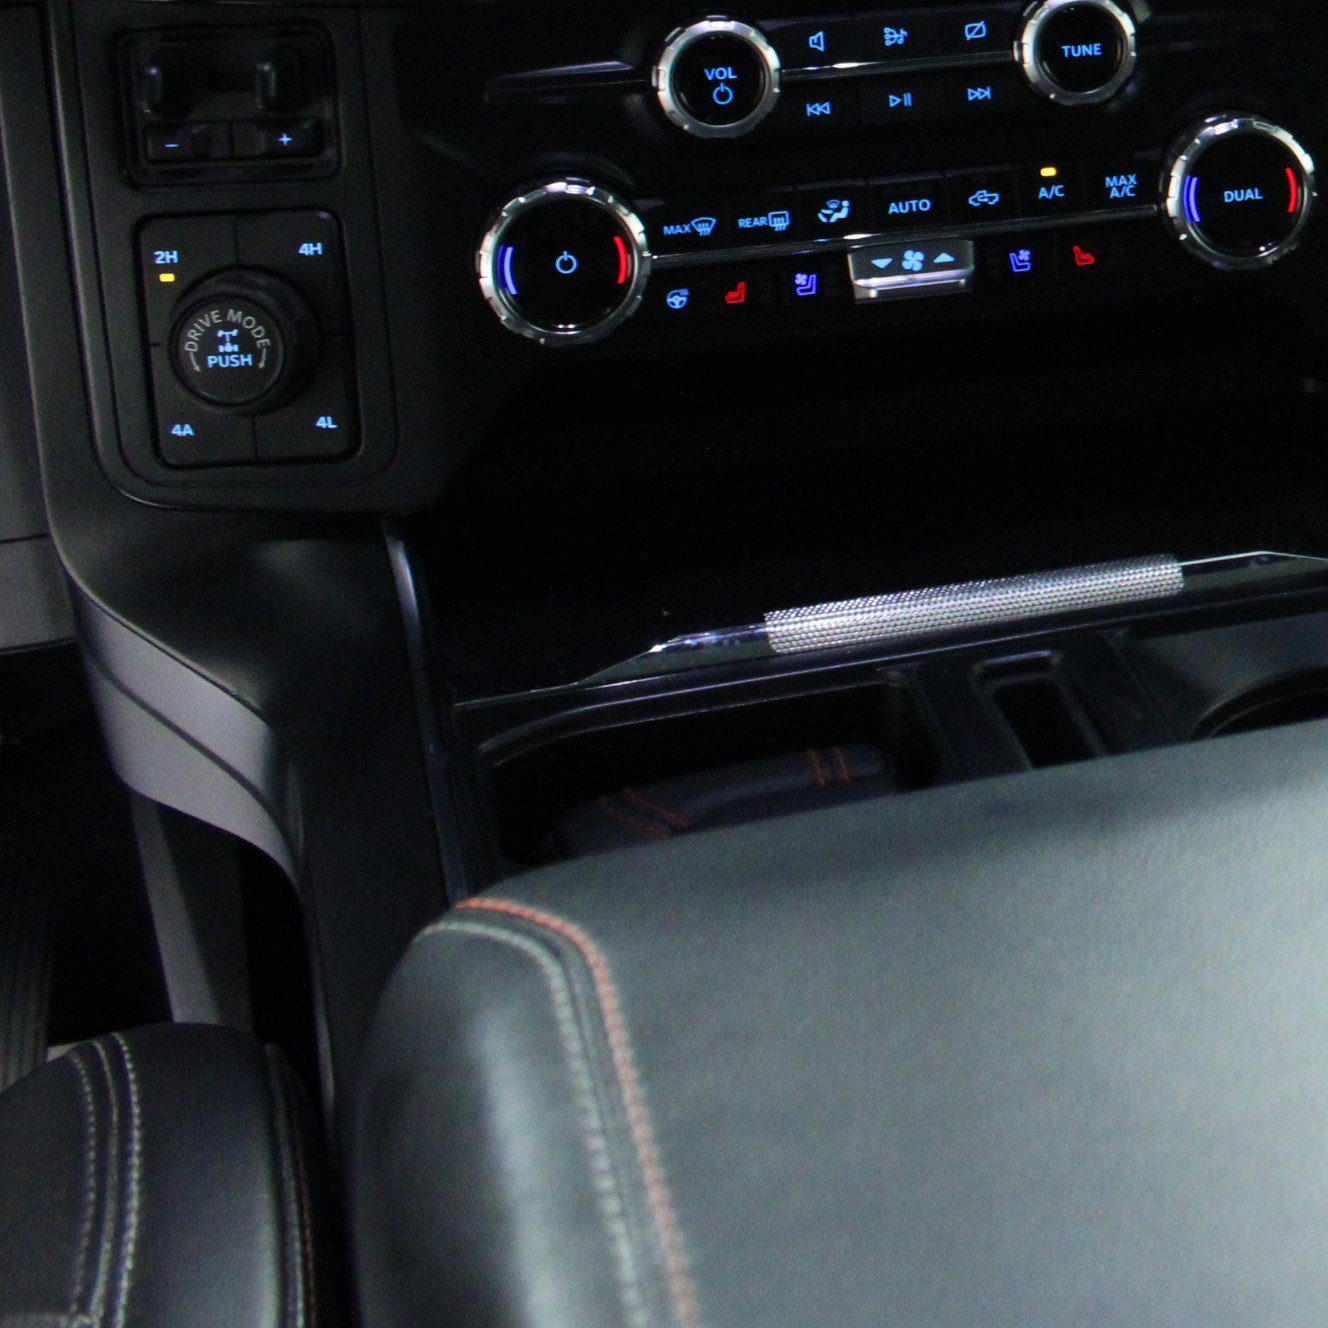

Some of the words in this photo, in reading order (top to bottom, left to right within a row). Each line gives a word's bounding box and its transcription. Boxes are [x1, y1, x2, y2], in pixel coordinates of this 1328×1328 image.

[1061, 43, 1102, 58] TUNE
[705, 67, 738, 81] VOL
[1105, 174, 1138, 186] MAX
[1039, 185, 1065, 200] A/C
[1109, 185, 1137, 198] A/C
[1224, 188, 1264, 203] DUAL
[889, 199, 931, 215] AUTO
[662, 224, 692, 236] MAX
[737, 217, 767, 229] REAR
[299, 243, 323, 256] 4H
[154, 251, 178, 265] 2H
[184, 309, 223, 352] DRIVE
[226, 308, 271, 349] MODE
[207, 354, 253, 369] PUSH
[316, 417, 338, 429] 4L
[171, 424, 195, 437] 4A
